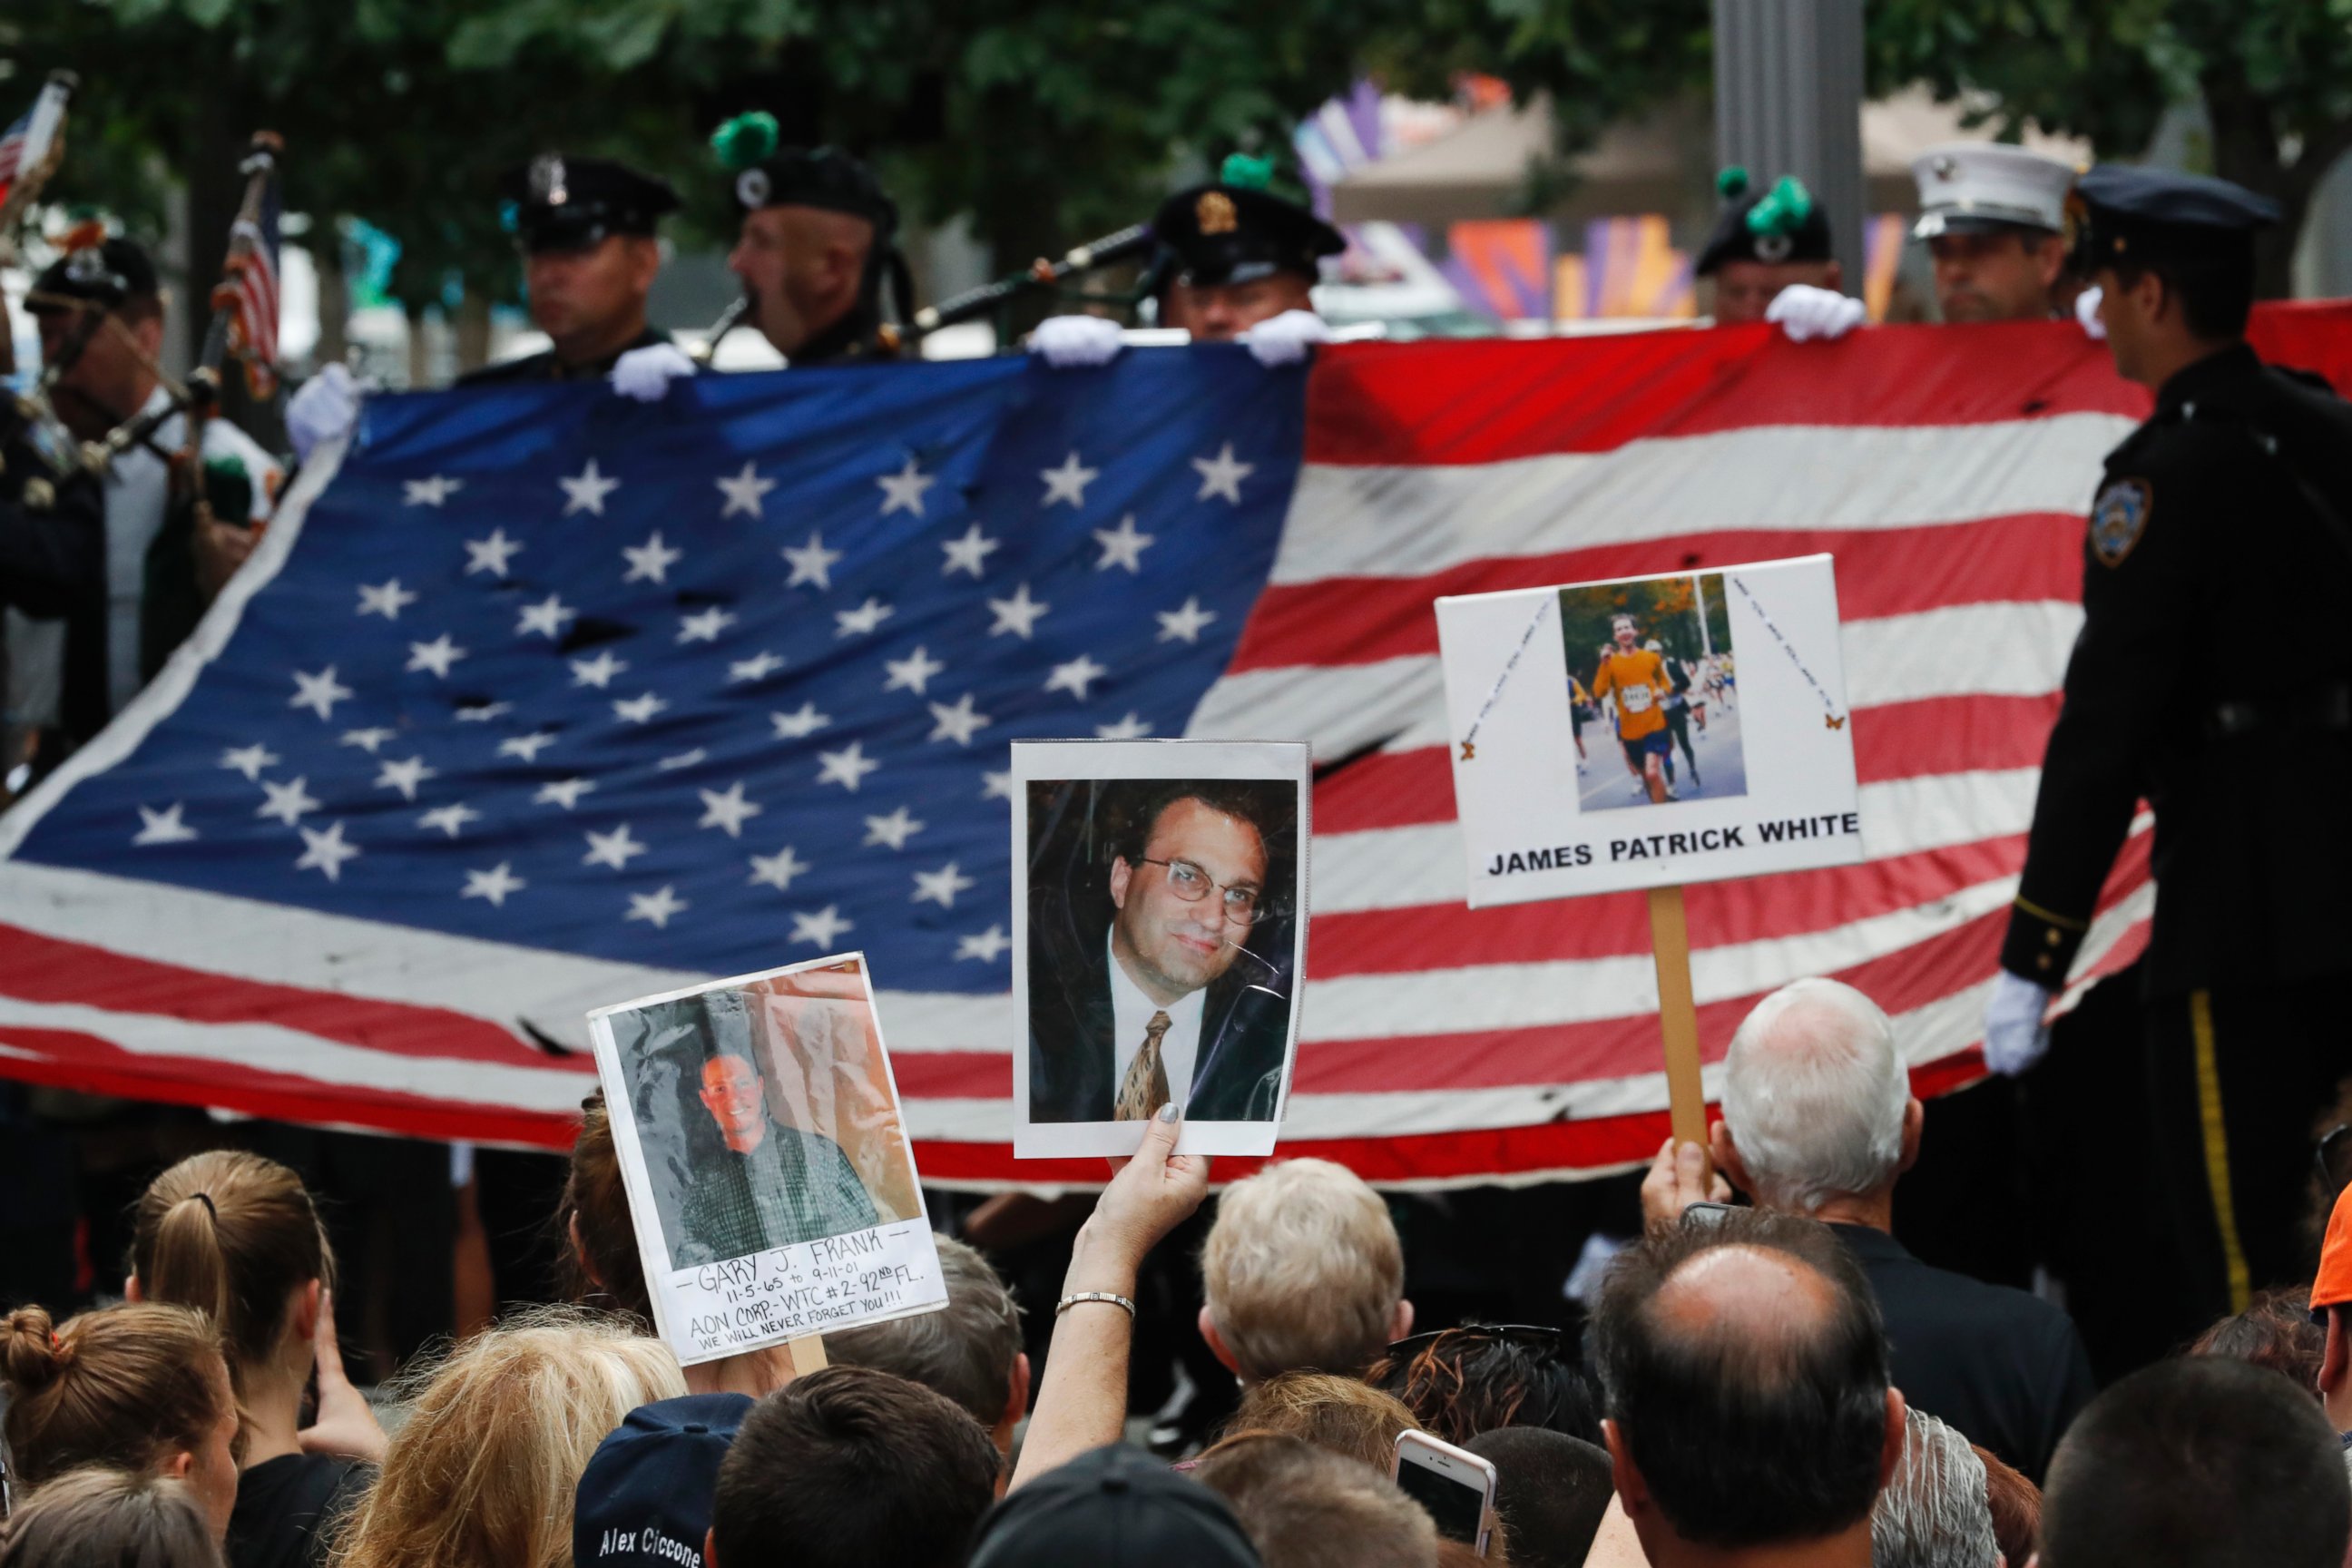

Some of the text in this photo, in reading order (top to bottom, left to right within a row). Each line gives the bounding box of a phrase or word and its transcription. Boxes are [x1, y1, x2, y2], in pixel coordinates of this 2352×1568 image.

[1488, 813, 1859, 877] JAMES PATRICK WHITE
[698, 1229, 884, 1294] GARY J. FRANK
[726, 1261, 858, 1303] 11-5-65 to 9-11-01
[691, 1312, 730, 1338] AON
[895, 1264, 925, 1285] FL.
[699, 1337, 720, 1350] WE
[760, 1313, 804, 1335] NEVER
[808, 1300, 856, 1323] FORGET
[599, 1526, 701, 1568] Alex Ciccone
